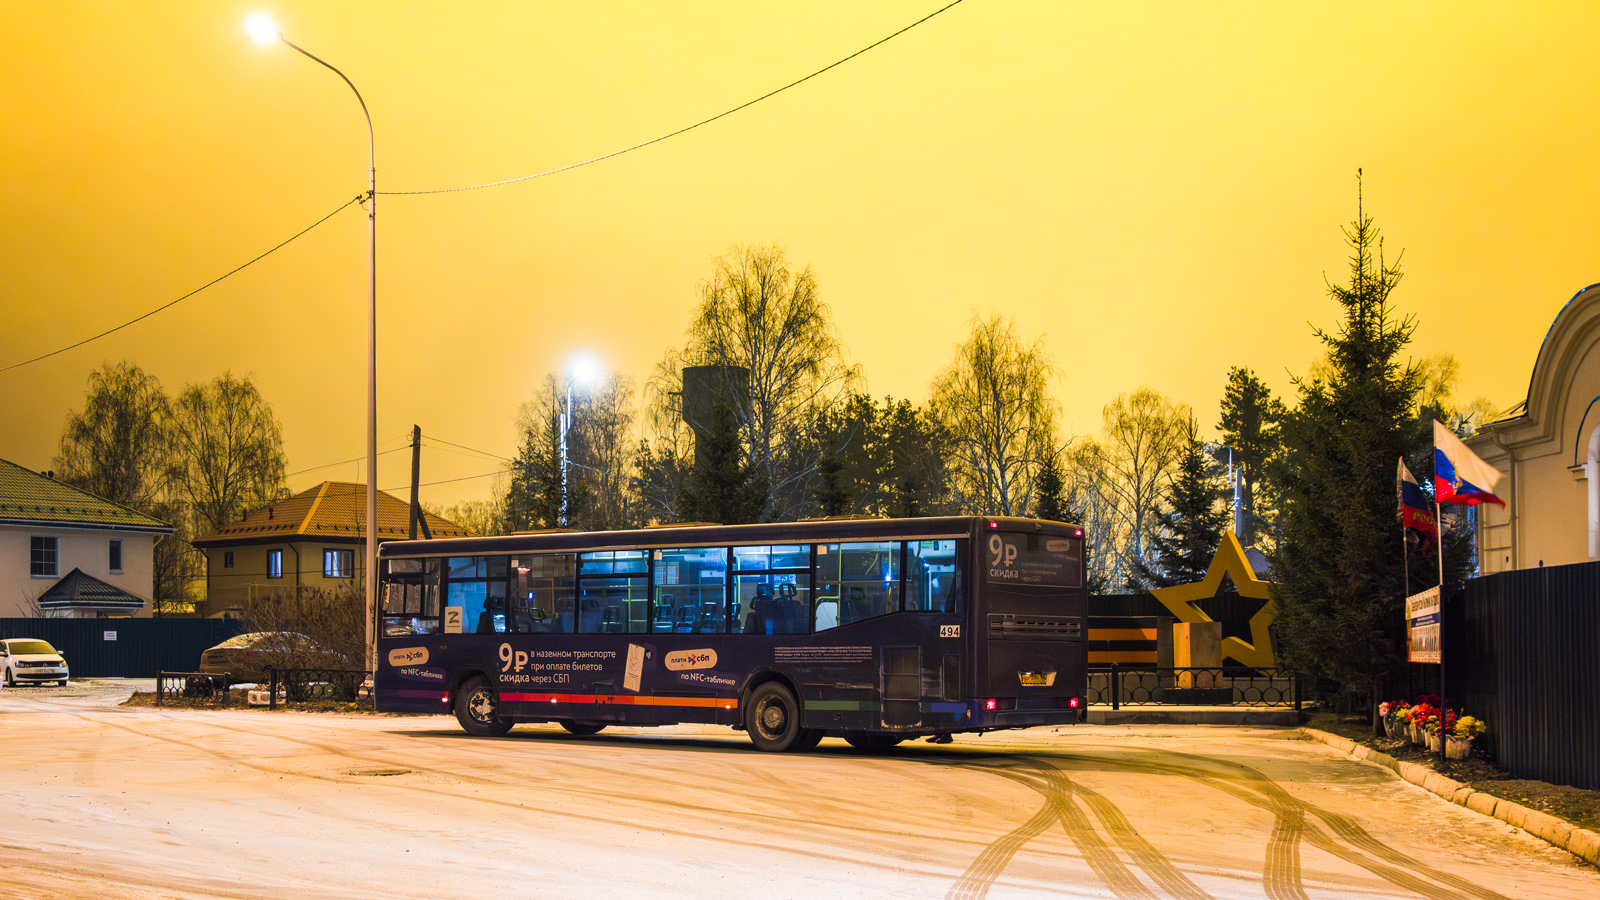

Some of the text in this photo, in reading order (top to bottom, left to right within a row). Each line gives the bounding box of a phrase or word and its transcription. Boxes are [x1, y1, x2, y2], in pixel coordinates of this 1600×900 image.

[989, 568, 1019, 579] скидка
[940, 626, 960, 637] 494
[413, 651, 424, 659] сбп
[536, 650, 572, 658] наземном
[573, 650, 617, 660] транспорте
[696, 654, 710, 662] сбп
[531, 660, 603, 672] при оплате билетов
[499, 674, 530, 683] скидка
[531, 673, 570, 684] через СБП
[680, 672, 736, 686] по NFC-табличке
